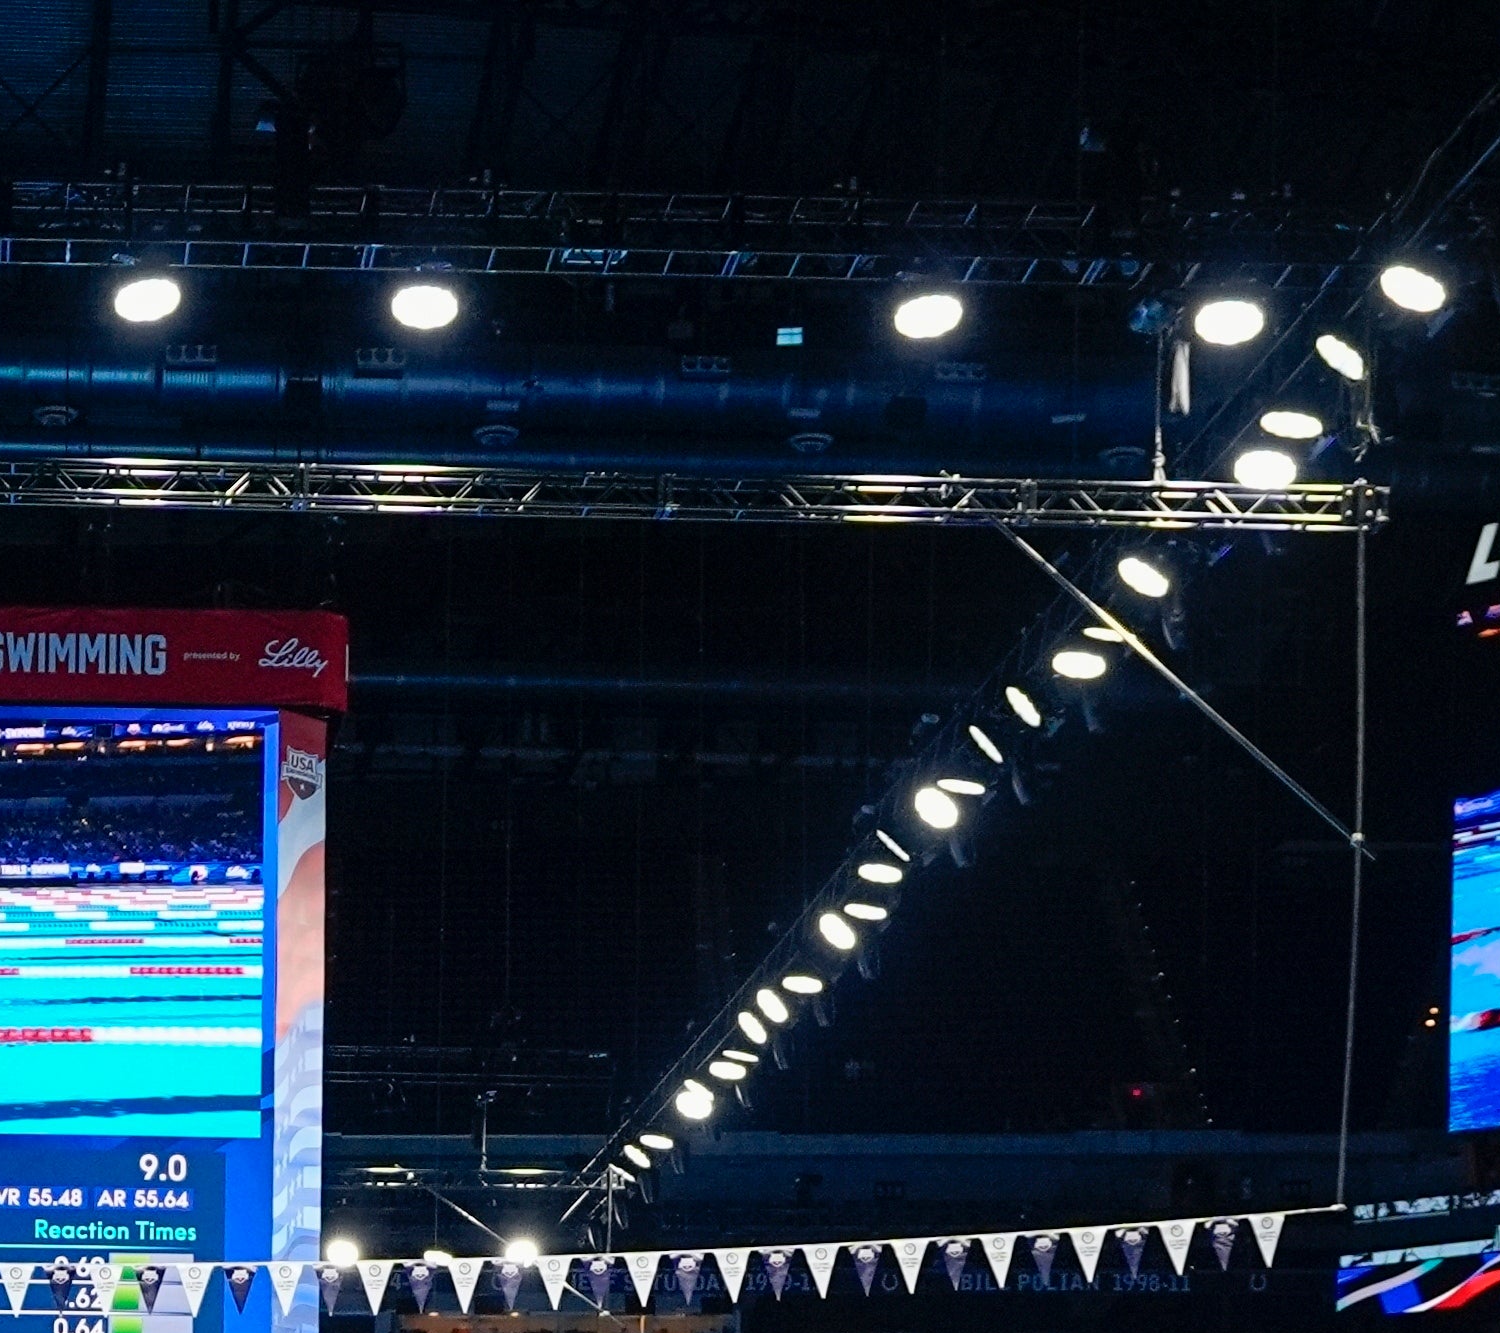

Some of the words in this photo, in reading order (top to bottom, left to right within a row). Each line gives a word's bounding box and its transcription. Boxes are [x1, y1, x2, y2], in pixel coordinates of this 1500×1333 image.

[257, 636, 330, 678] Lilly
[290, 754, 315, 773] USA
[138, 1153, 189, 1183] 9.0
[27, 1187, 84, 1209] 55.48
[33, 1219, 131, 1241] Reaction
[134, 1221, 198, 1243] Times
